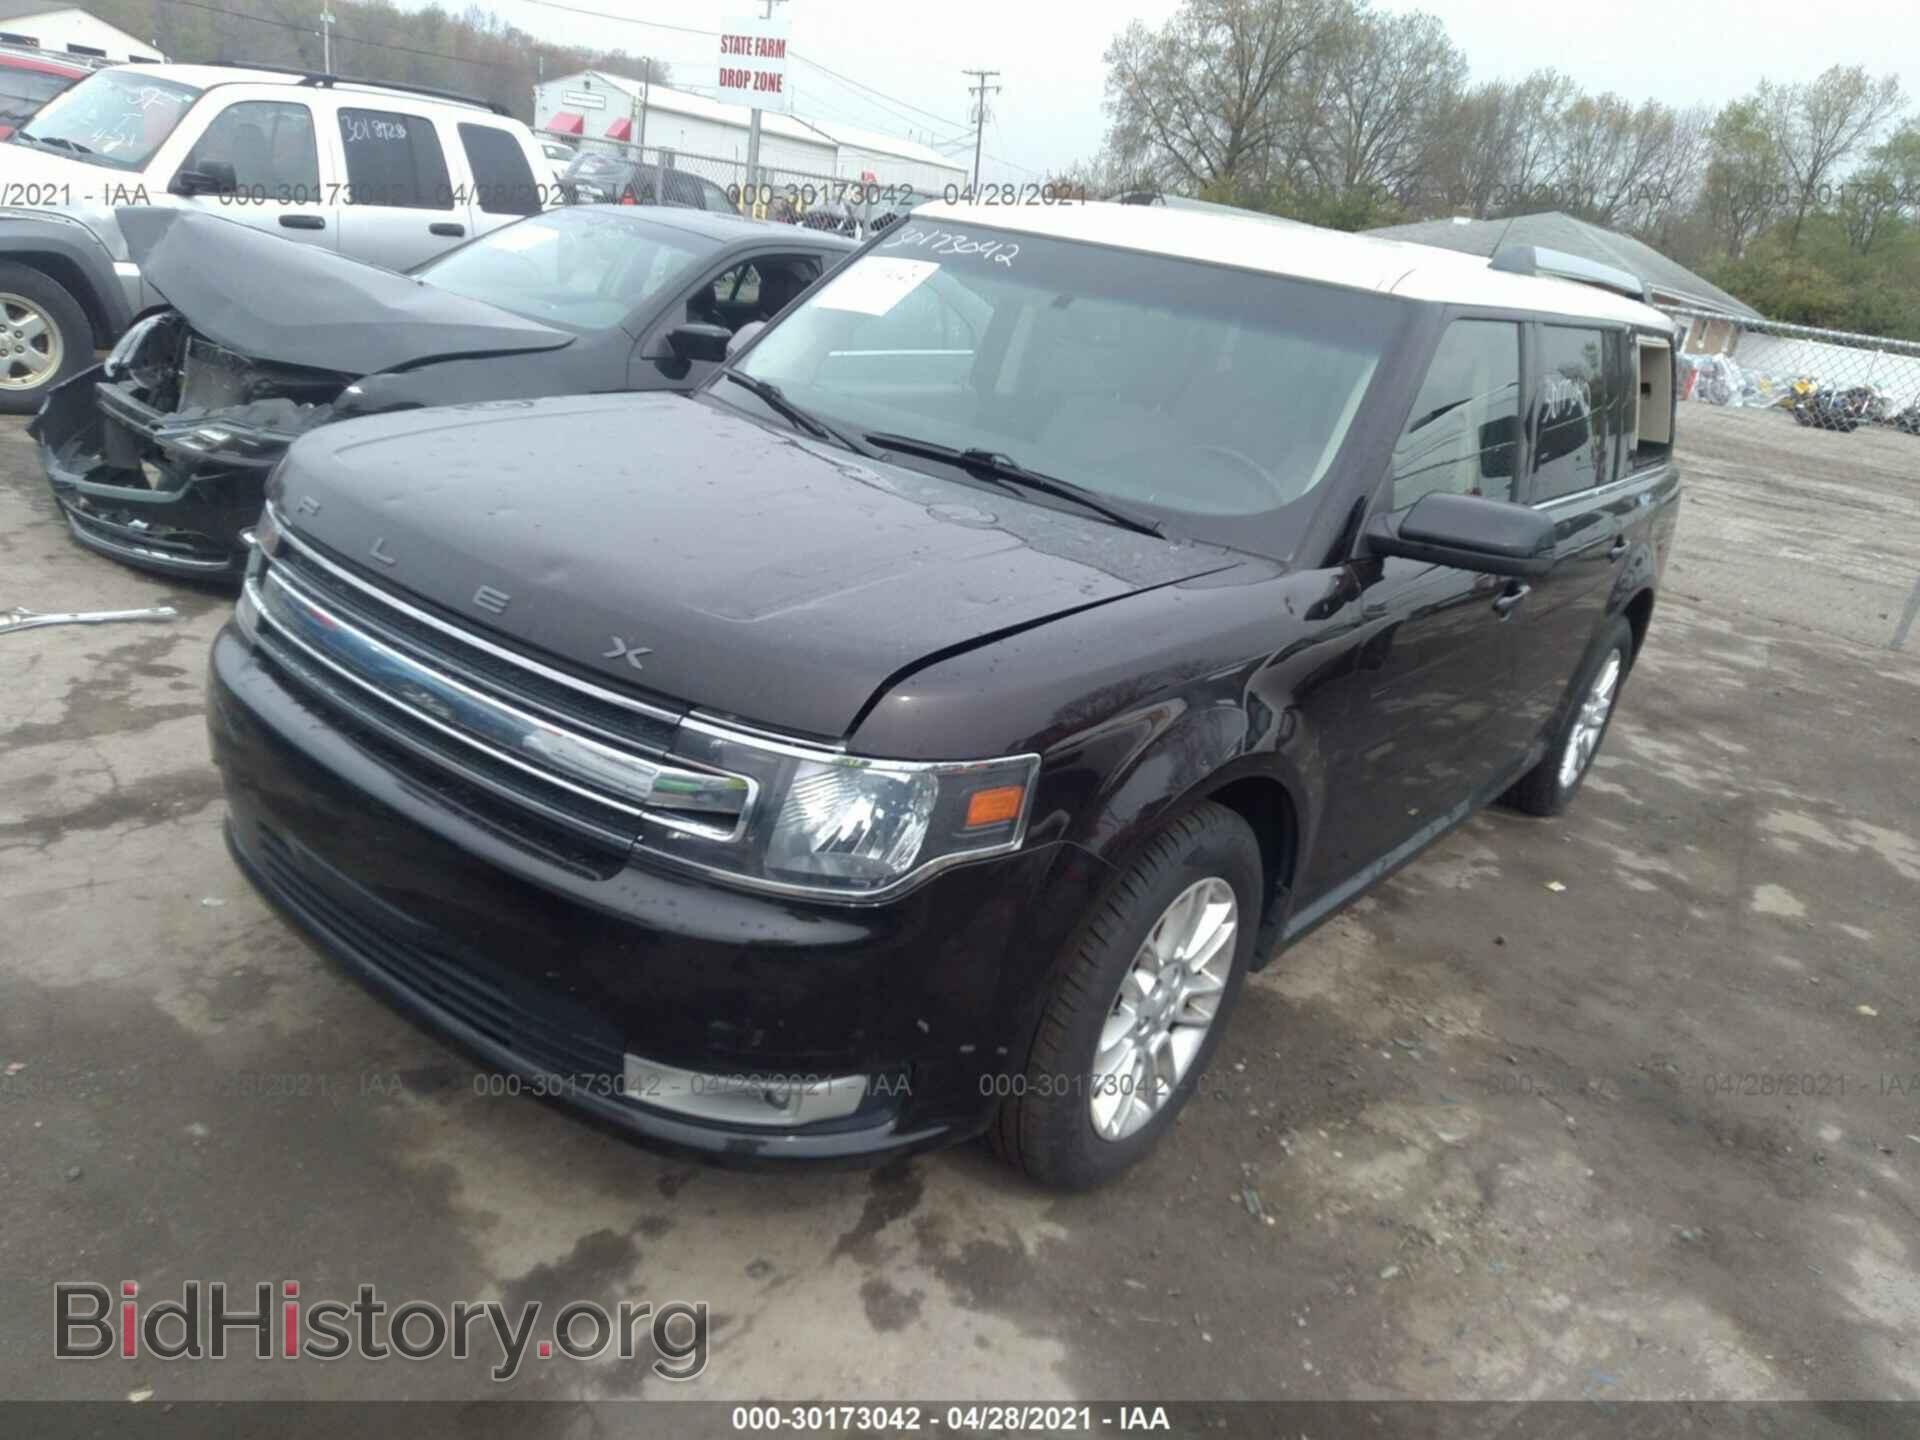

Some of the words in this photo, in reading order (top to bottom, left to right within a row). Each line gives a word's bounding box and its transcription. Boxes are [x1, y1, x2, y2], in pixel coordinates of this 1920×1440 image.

[720, 34, 752, 56] STATE
[755, 36, 785, 59] FARM
[719, 67, 751, 89] DROP
[753, 71, 783, 93] ZONE
